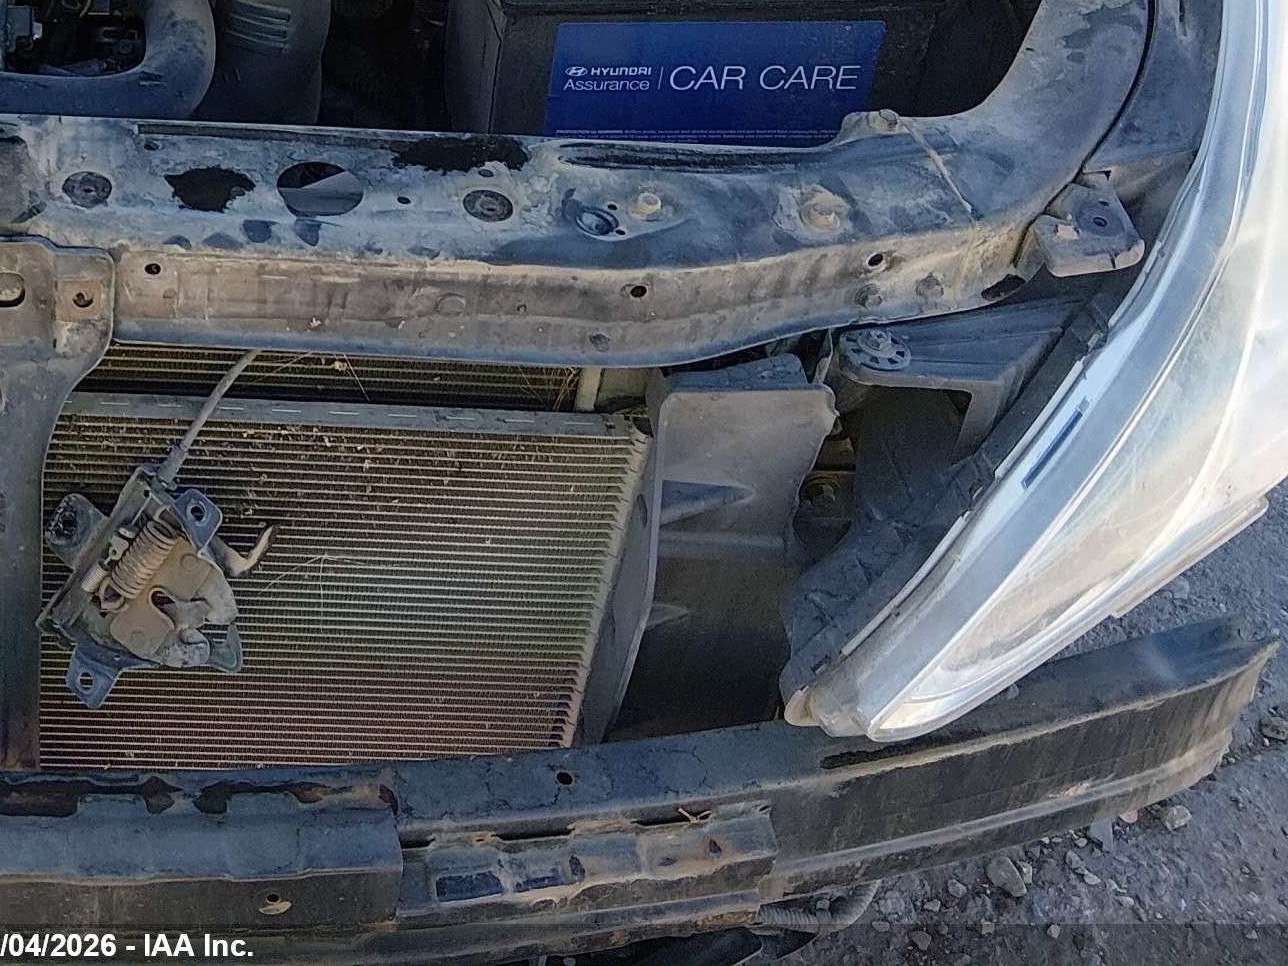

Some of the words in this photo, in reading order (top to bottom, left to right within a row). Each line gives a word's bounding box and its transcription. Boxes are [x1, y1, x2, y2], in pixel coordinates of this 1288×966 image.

[590, 66, 652, 76] HYUNDAI
[562, 78, 650, 91] Assurance
[669, 65, 747, 91] CAR
[759, 65, 862, 91] CARE
